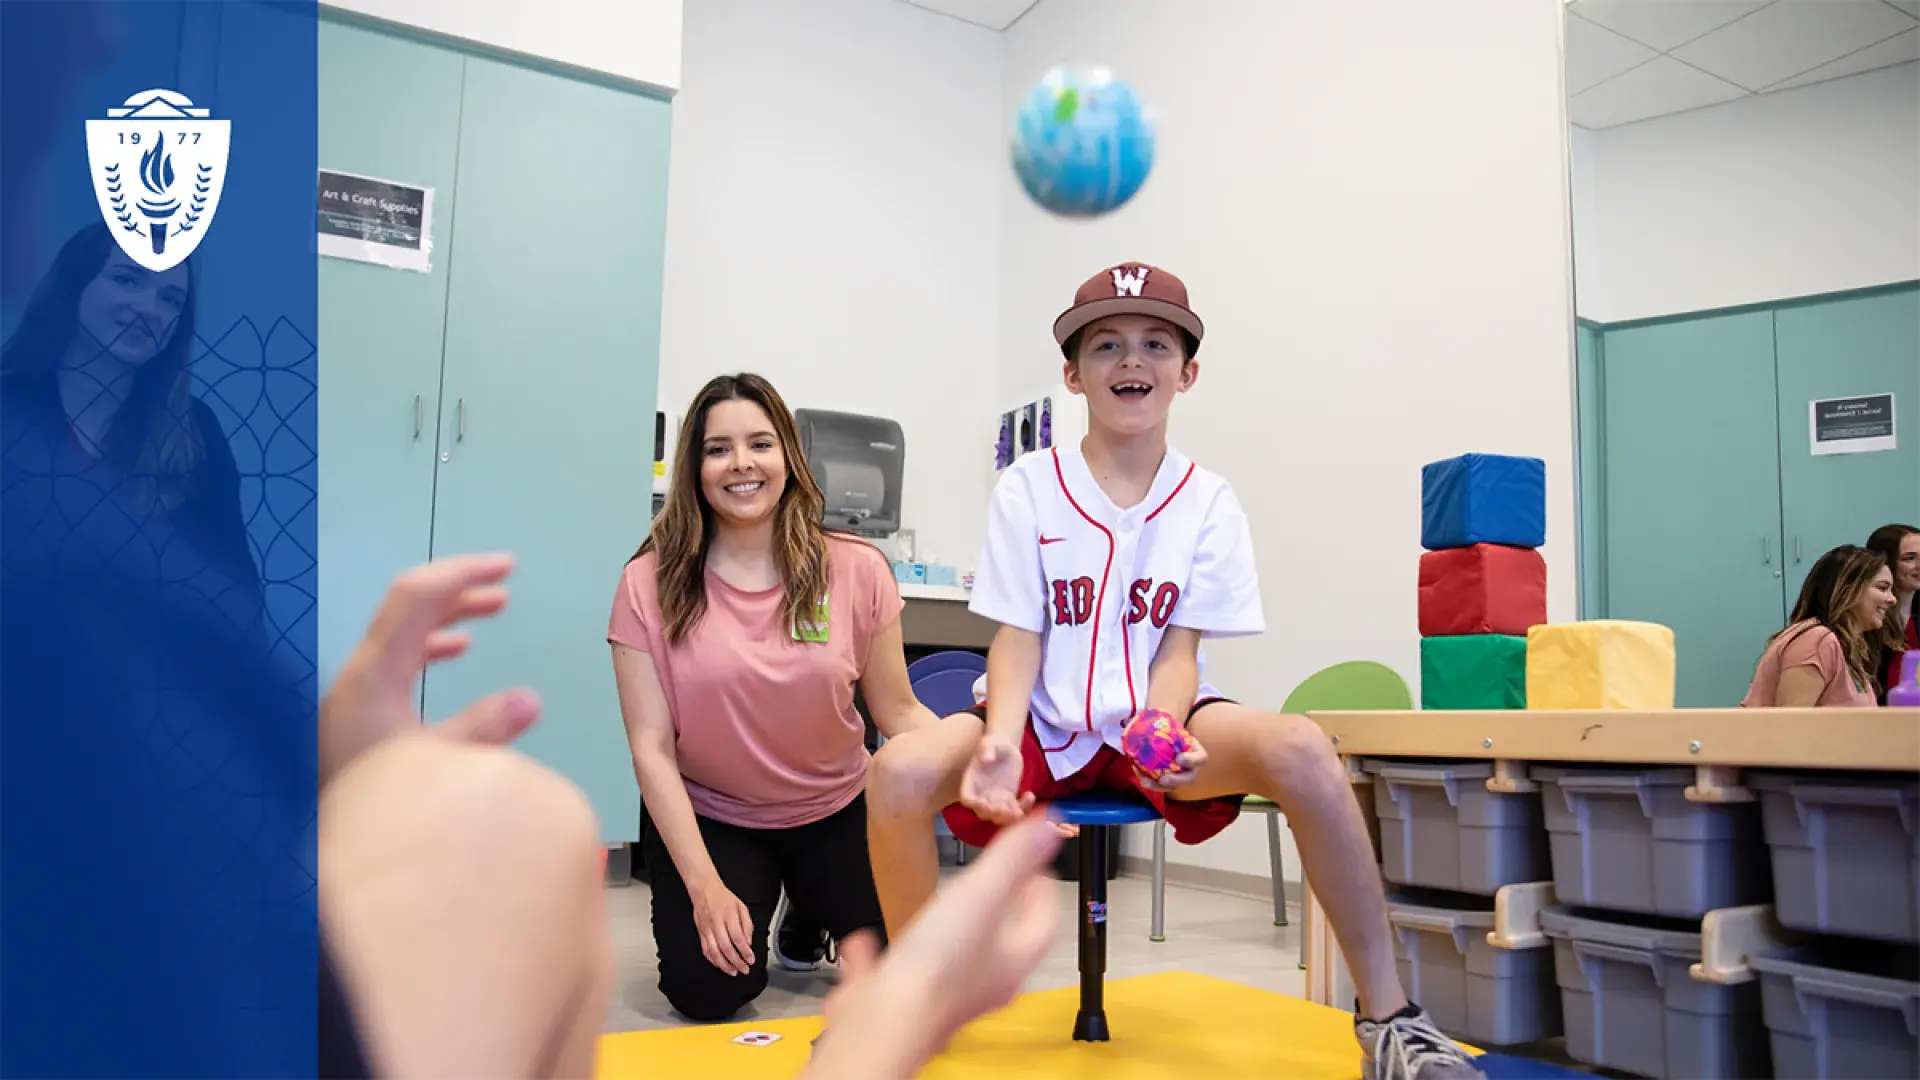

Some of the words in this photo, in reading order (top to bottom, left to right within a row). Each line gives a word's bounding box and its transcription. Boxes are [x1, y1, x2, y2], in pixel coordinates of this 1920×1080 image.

[323, 189, 339, 200] Art
[341, 191, 350, 202] &
[351, 193, 377, 207] Craft
[379, 198, 419, 215] Supplies
[1109, 265, 1152, 298] W
[1051, 576, 1096, 627] ED
[1128, 576, 1180, 629] SO
